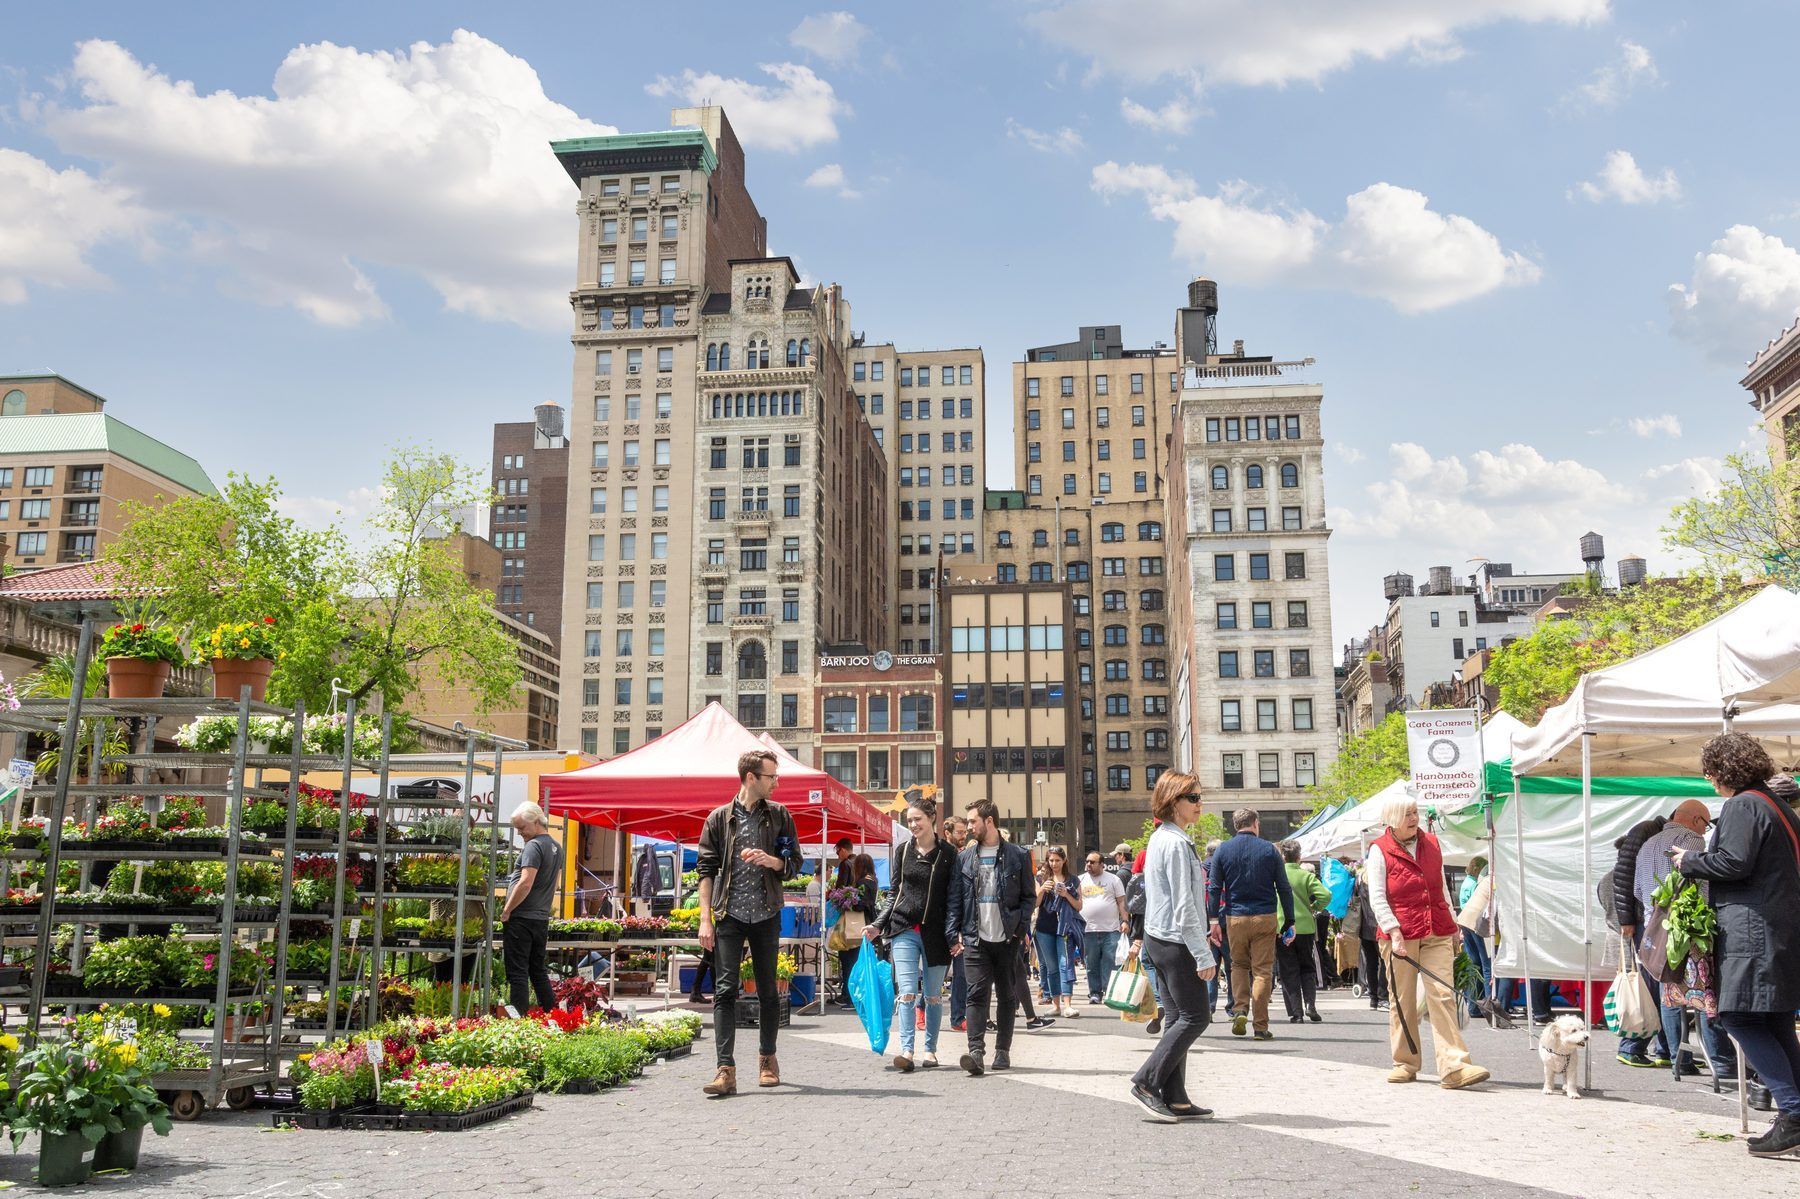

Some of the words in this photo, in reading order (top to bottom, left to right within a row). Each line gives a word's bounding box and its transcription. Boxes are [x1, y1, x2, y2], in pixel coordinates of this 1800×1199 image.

[820, 658, 846, 667] BARN
[848, 657, 870, 666] JOO
[897, 657, 910, 665] THE
[911, 657, 936, 665] GRAIN
[1415, 771, 1474, 781] Handmade
[1416, 781, 1477, 790] Farmstead
[1424, 791, 1470, 800] Cheeses
